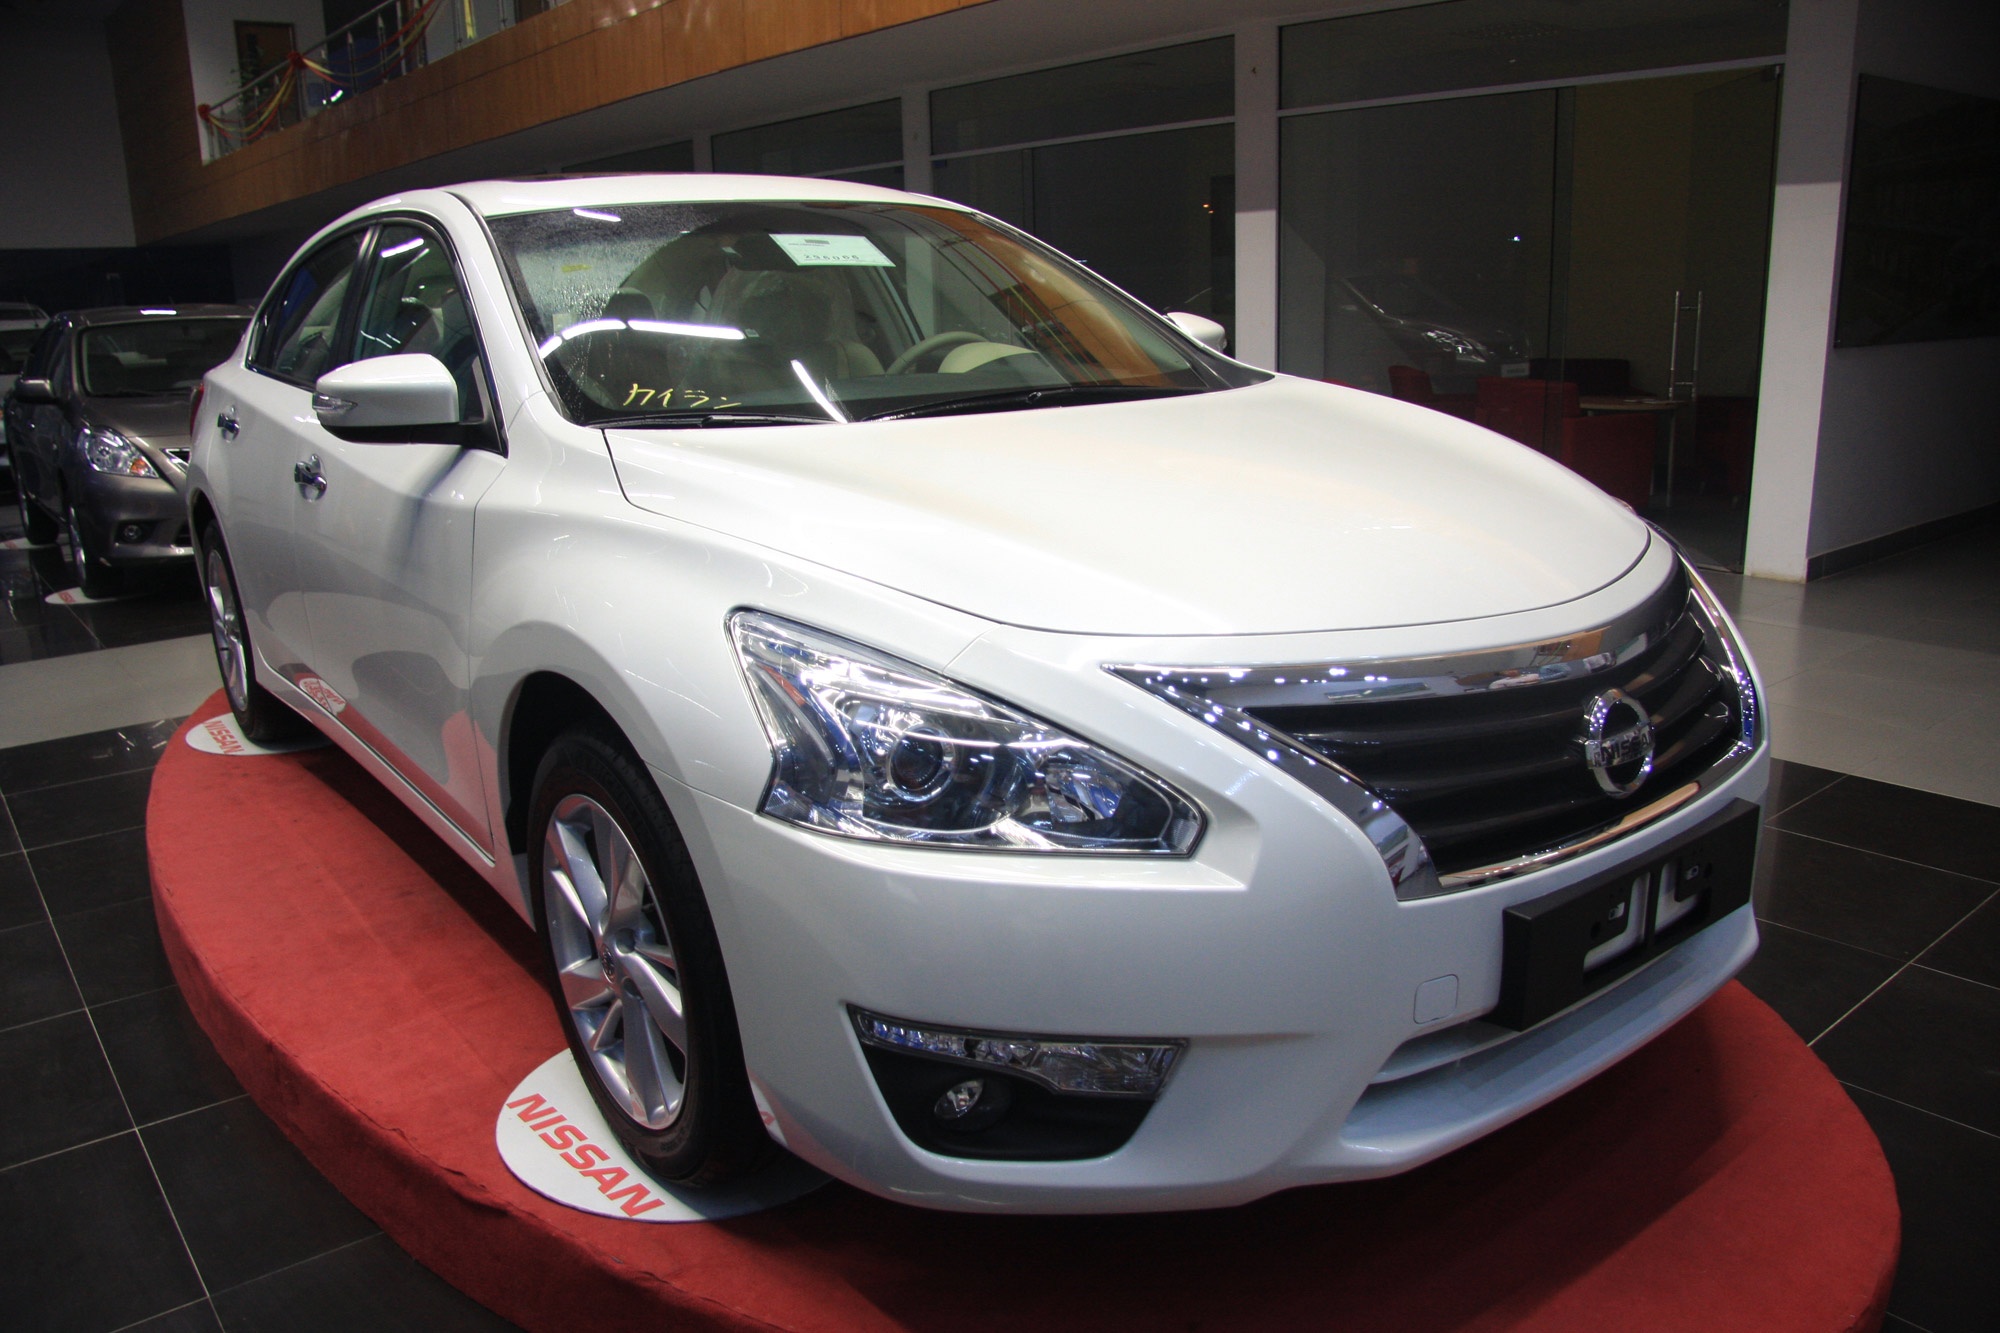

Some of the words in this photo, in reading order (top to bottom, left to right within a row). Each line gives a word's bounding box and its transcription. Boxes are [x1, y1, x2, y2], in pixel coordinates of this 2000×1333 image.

[204, 720, 246, 754] NISSAN
[1600, 729, 1654, 764] NISSA
[505, 1092, 666, 1218] NISSAN
